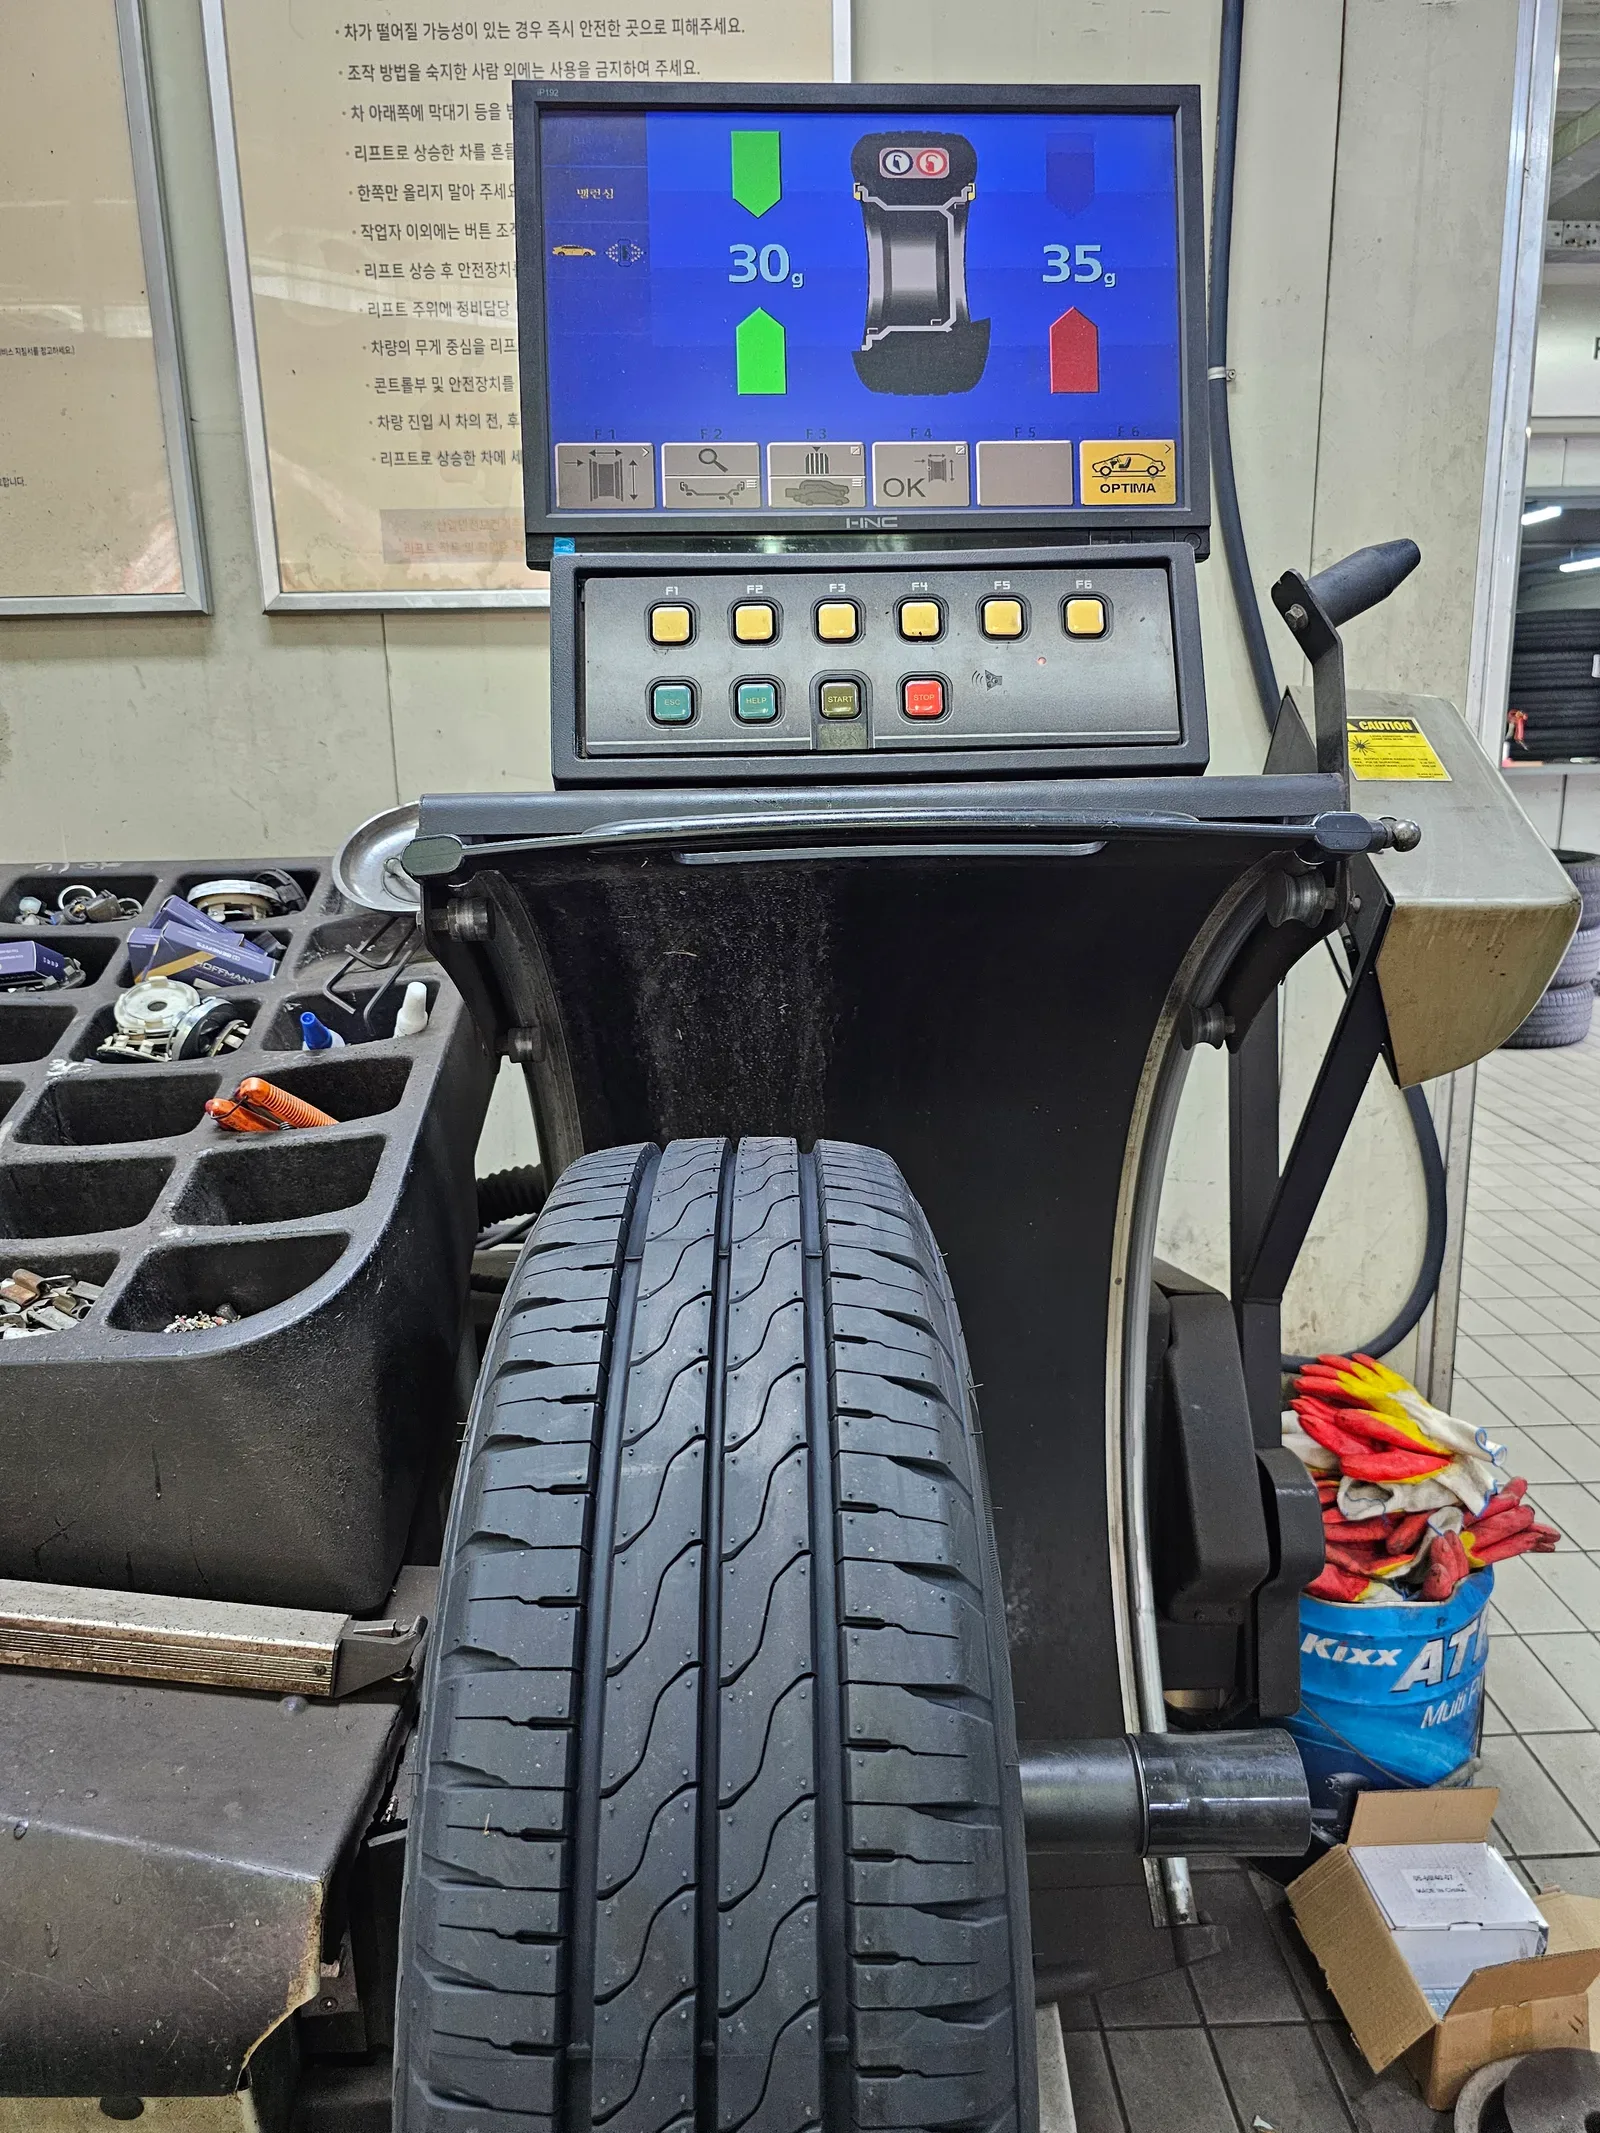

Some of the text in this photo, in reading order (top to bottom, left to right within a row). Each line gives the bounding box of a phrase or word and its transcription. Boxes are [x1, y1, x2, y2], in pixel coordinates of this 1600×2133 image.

[344, 16, 745, 41] 차가 떨어질 가능성이 있는 경우 즉시 안전한 곳으로 피해주세요.
[347, 58, 701, 82] 조작 방법을 숙지한 사람 외에는 사용을 금지하여 주세요.
[350, 104, 365, 122] 차
[368, 103, 424, 122] 아래쪽에
[428, 102, 469, 121] 막대기
[473, 102, 502, 122] 등을
[353, 144, 410, 163] 리프트로
[413, 143, 455, 162] 상승한
[459, 142, 487, 161] 차를
[357, 184, 399, 203] 한쪽만
[402, 183, 443, 202] 올리지
[447, 183, 475, 202] 말아
[360, 223, 402, 241] 작업자
[405, 222, 460, 241] 이외에는
[464, 222, 492, 240] 버튼
[364, 262, 405, 280] 리프트
[409, 261, 437, 280] 상승
[440, 261, 454, 280] 후
[367, 300, 510, 319] 리프트 주위에 정비담당
[371, 338, 411, 357] 차량의
[415, 338, 442, 356] 무게
[445, 337, 486, 356] 중심을
[373, 374, 515, 394] 콘트롤부 및 안전장치를
[377, 414, 404, 432] 차량
[407, 413, 434, 431] 진입
[438, 413, 451, 430] 시
[455, 412, 481, 430] 차의
[486, 412, 503, 430] 전,
[380, 450, 433, 467] 리프트로
[436, 450, 476, 467] 상승한
[480, 449, 507, 466] 차에
[882, 477, 927, 499] OK
[1099, 482, 1157, 495] OPTIMA
[665, 586, 679, 596] F1
[746, 584, 764, 594] F2
[829, 583, 846, 593] F3
[911, 581, 929, 591] F4
[993, 580, 1011, 590] F5
[1075, 579, 1092, 589] F6
[664, 698, 681, 706] ESC
[745, 696, 767, 705] HELP
[827, 695, 853, 704] START
[913, 693, 935, 702] STOP
[1358, 720, 1413, 731] CAUTION
[1300, 1632, 1402, 1667] Kixx
[1420, 1686, 1469, 1729] Multi
